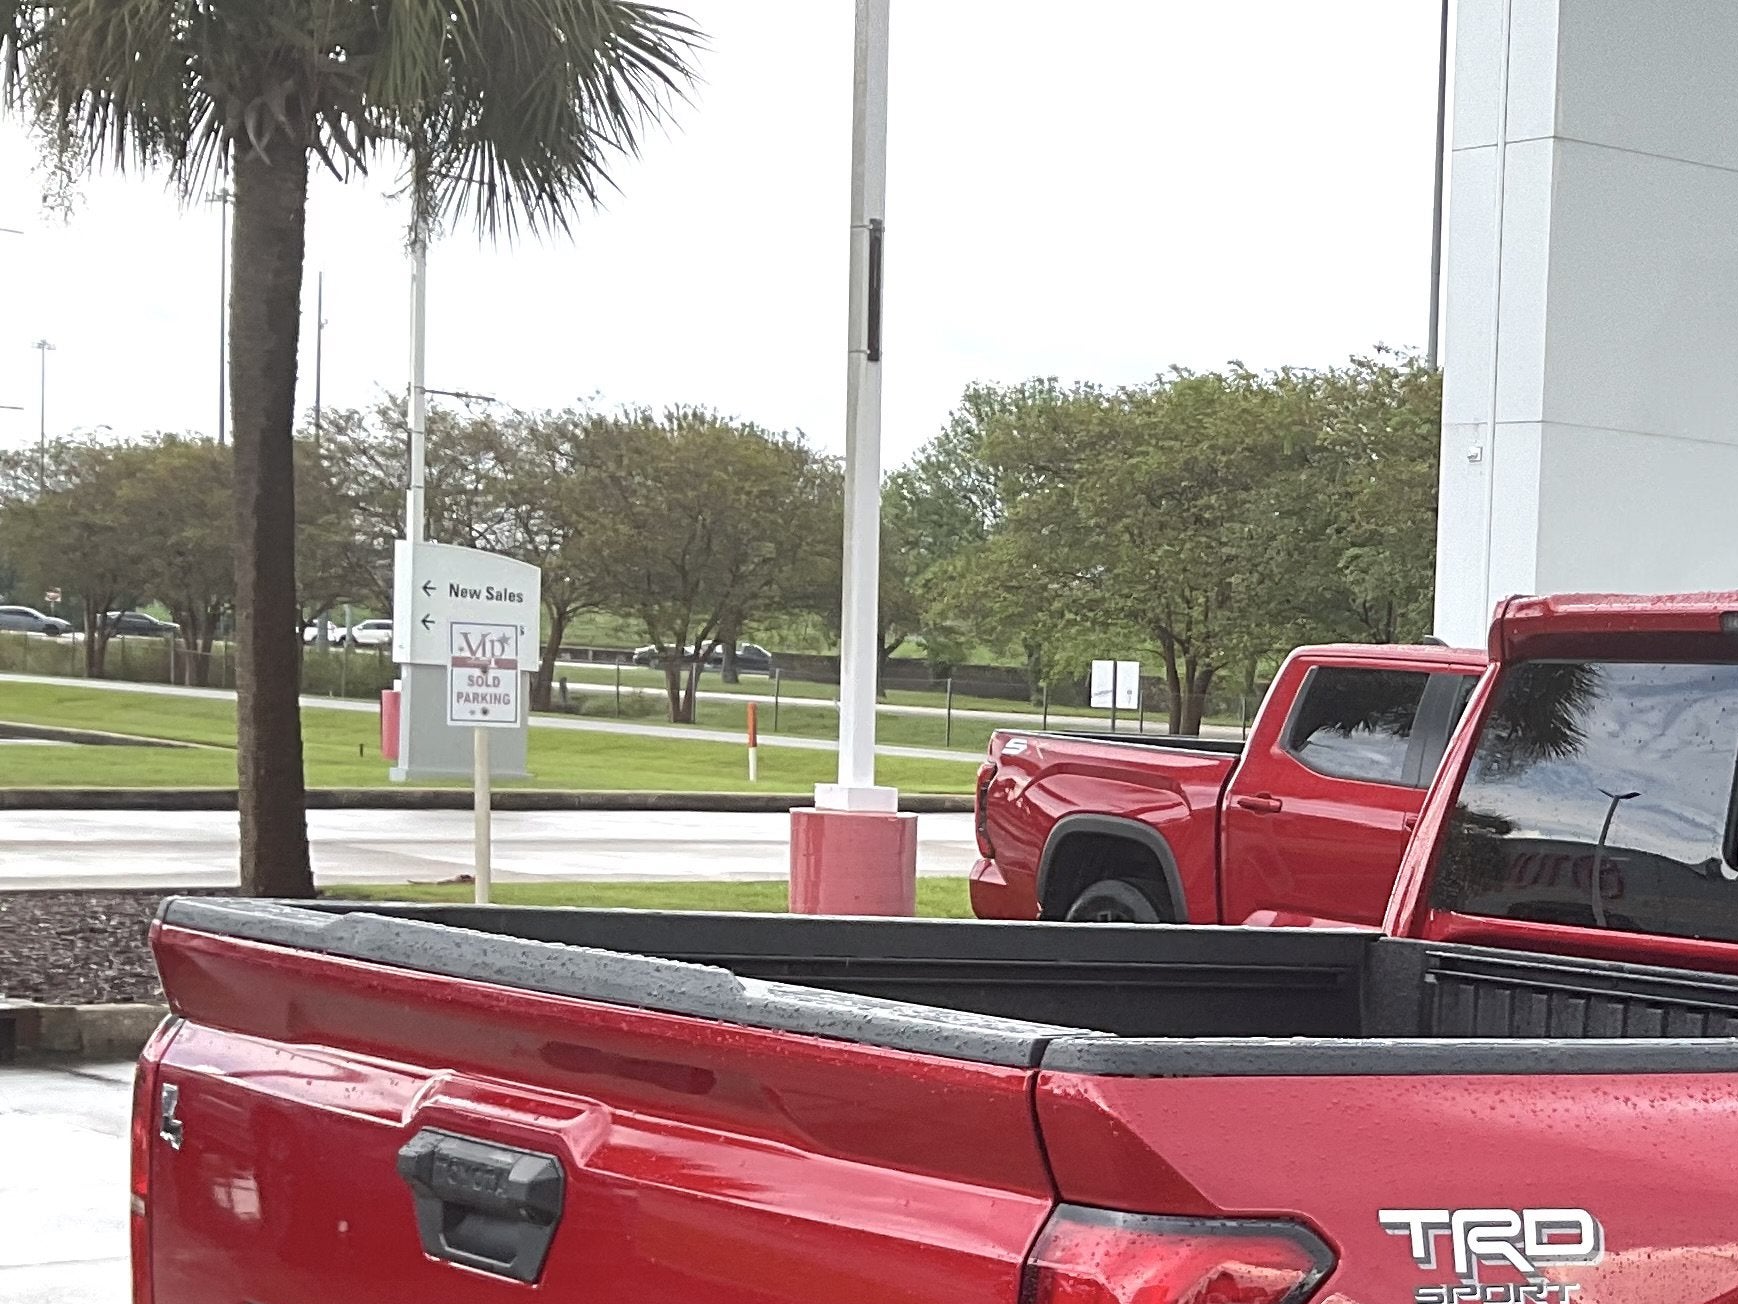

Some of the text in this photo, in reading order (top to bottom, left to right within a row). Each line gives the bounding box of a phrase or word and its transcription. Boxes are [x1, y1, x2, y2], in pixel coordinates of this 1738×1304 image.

[449, 583, 524, 603] New Sales
[467, 675, 501, 688] SOLD
[456, 691, 511, 706] PARKING
[1377, 1207, 1602, 1278] TRD
